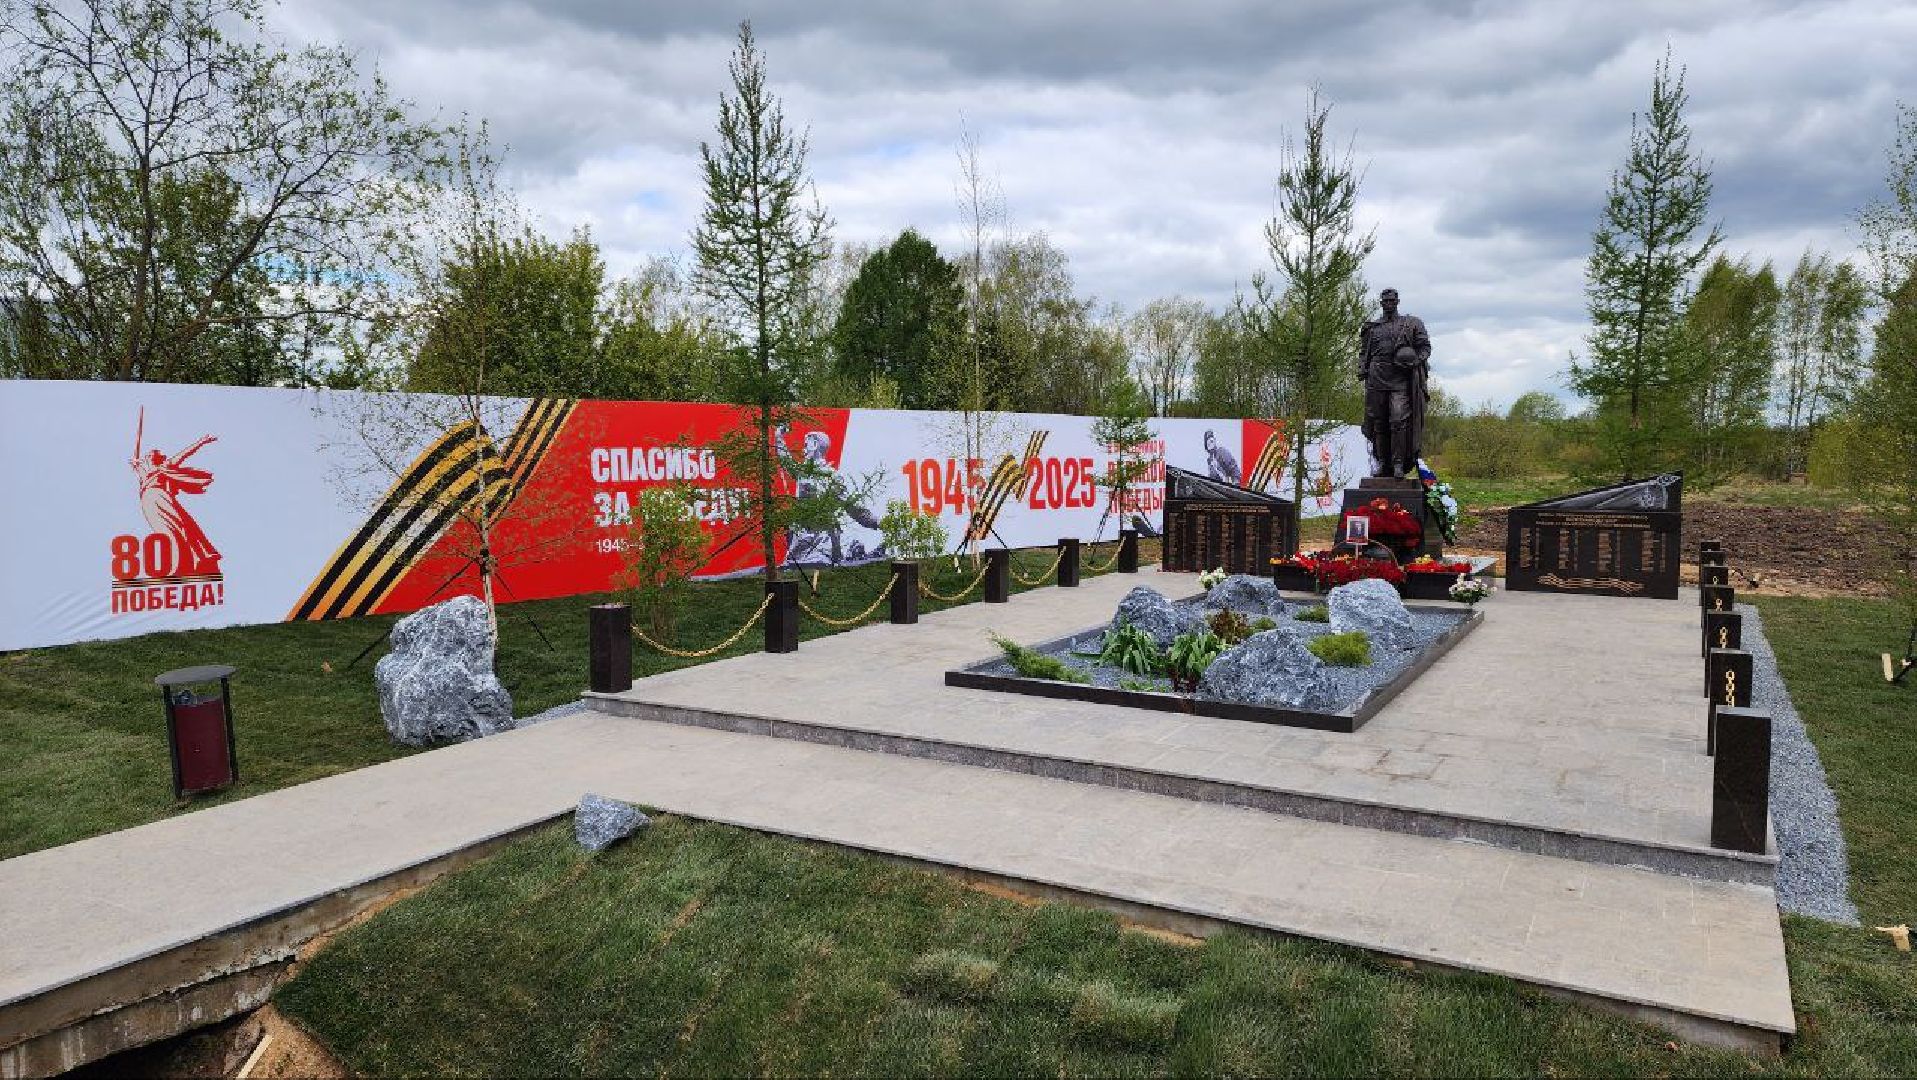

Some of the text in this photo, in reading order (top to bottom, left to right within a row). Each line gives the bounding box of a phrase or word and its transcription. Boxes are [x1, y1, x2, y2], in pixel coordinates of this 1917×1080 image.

[591, 447, 716, 483] СПАСИБО
[1107, 456, 1166, 483] ВКОЙ
[902, 457, 1097, 517] 1945 2025
[593, 491, 632, 527] ЗА
[111, 533, 172, 580] 80
[111, 583, 224, 614] ПОБЕДА!
